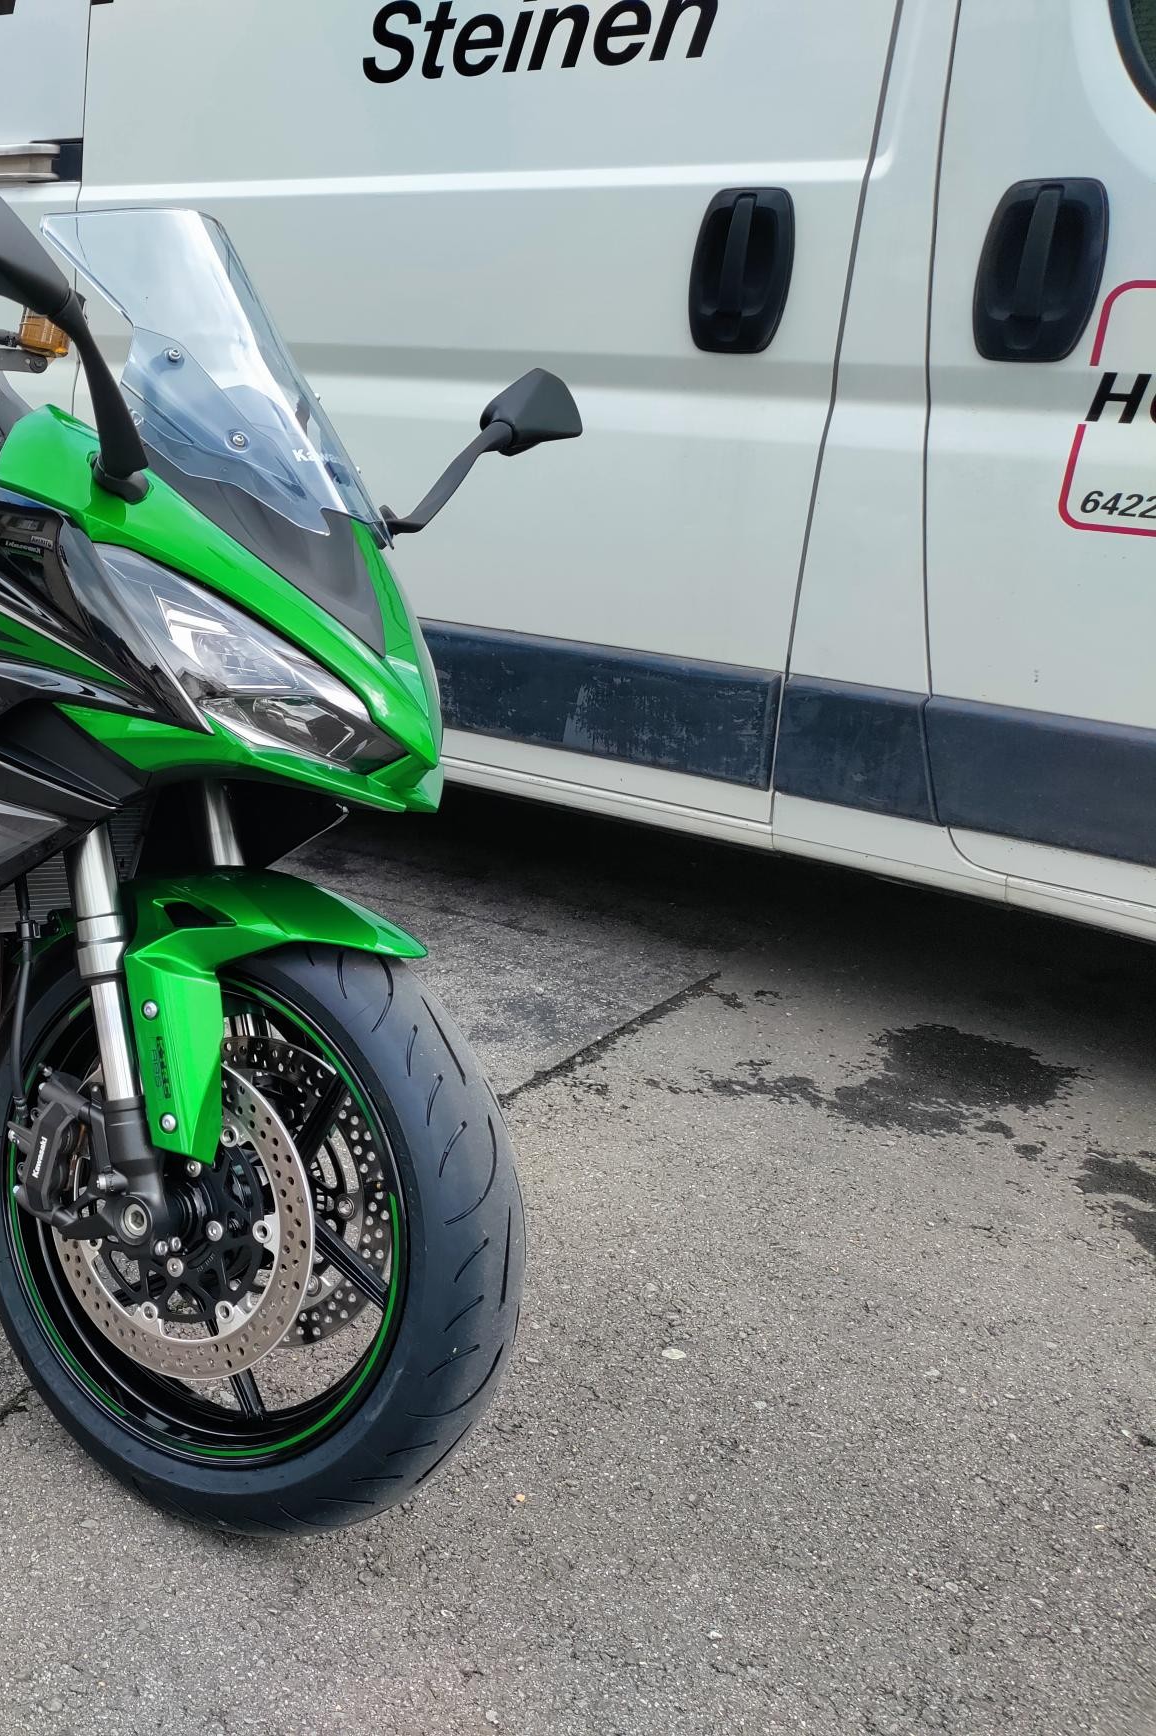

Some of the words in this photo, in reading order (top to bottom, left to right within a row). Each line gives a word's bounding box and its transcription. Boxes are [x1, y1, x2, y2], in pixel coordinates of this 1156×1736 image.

[362, 0, 719, 84] Steinen
[1085, 372, 1156, 424] H
[1080, 490, 1156, 519] 6422
[31, 1136, 48, 1179] Kawasaki
